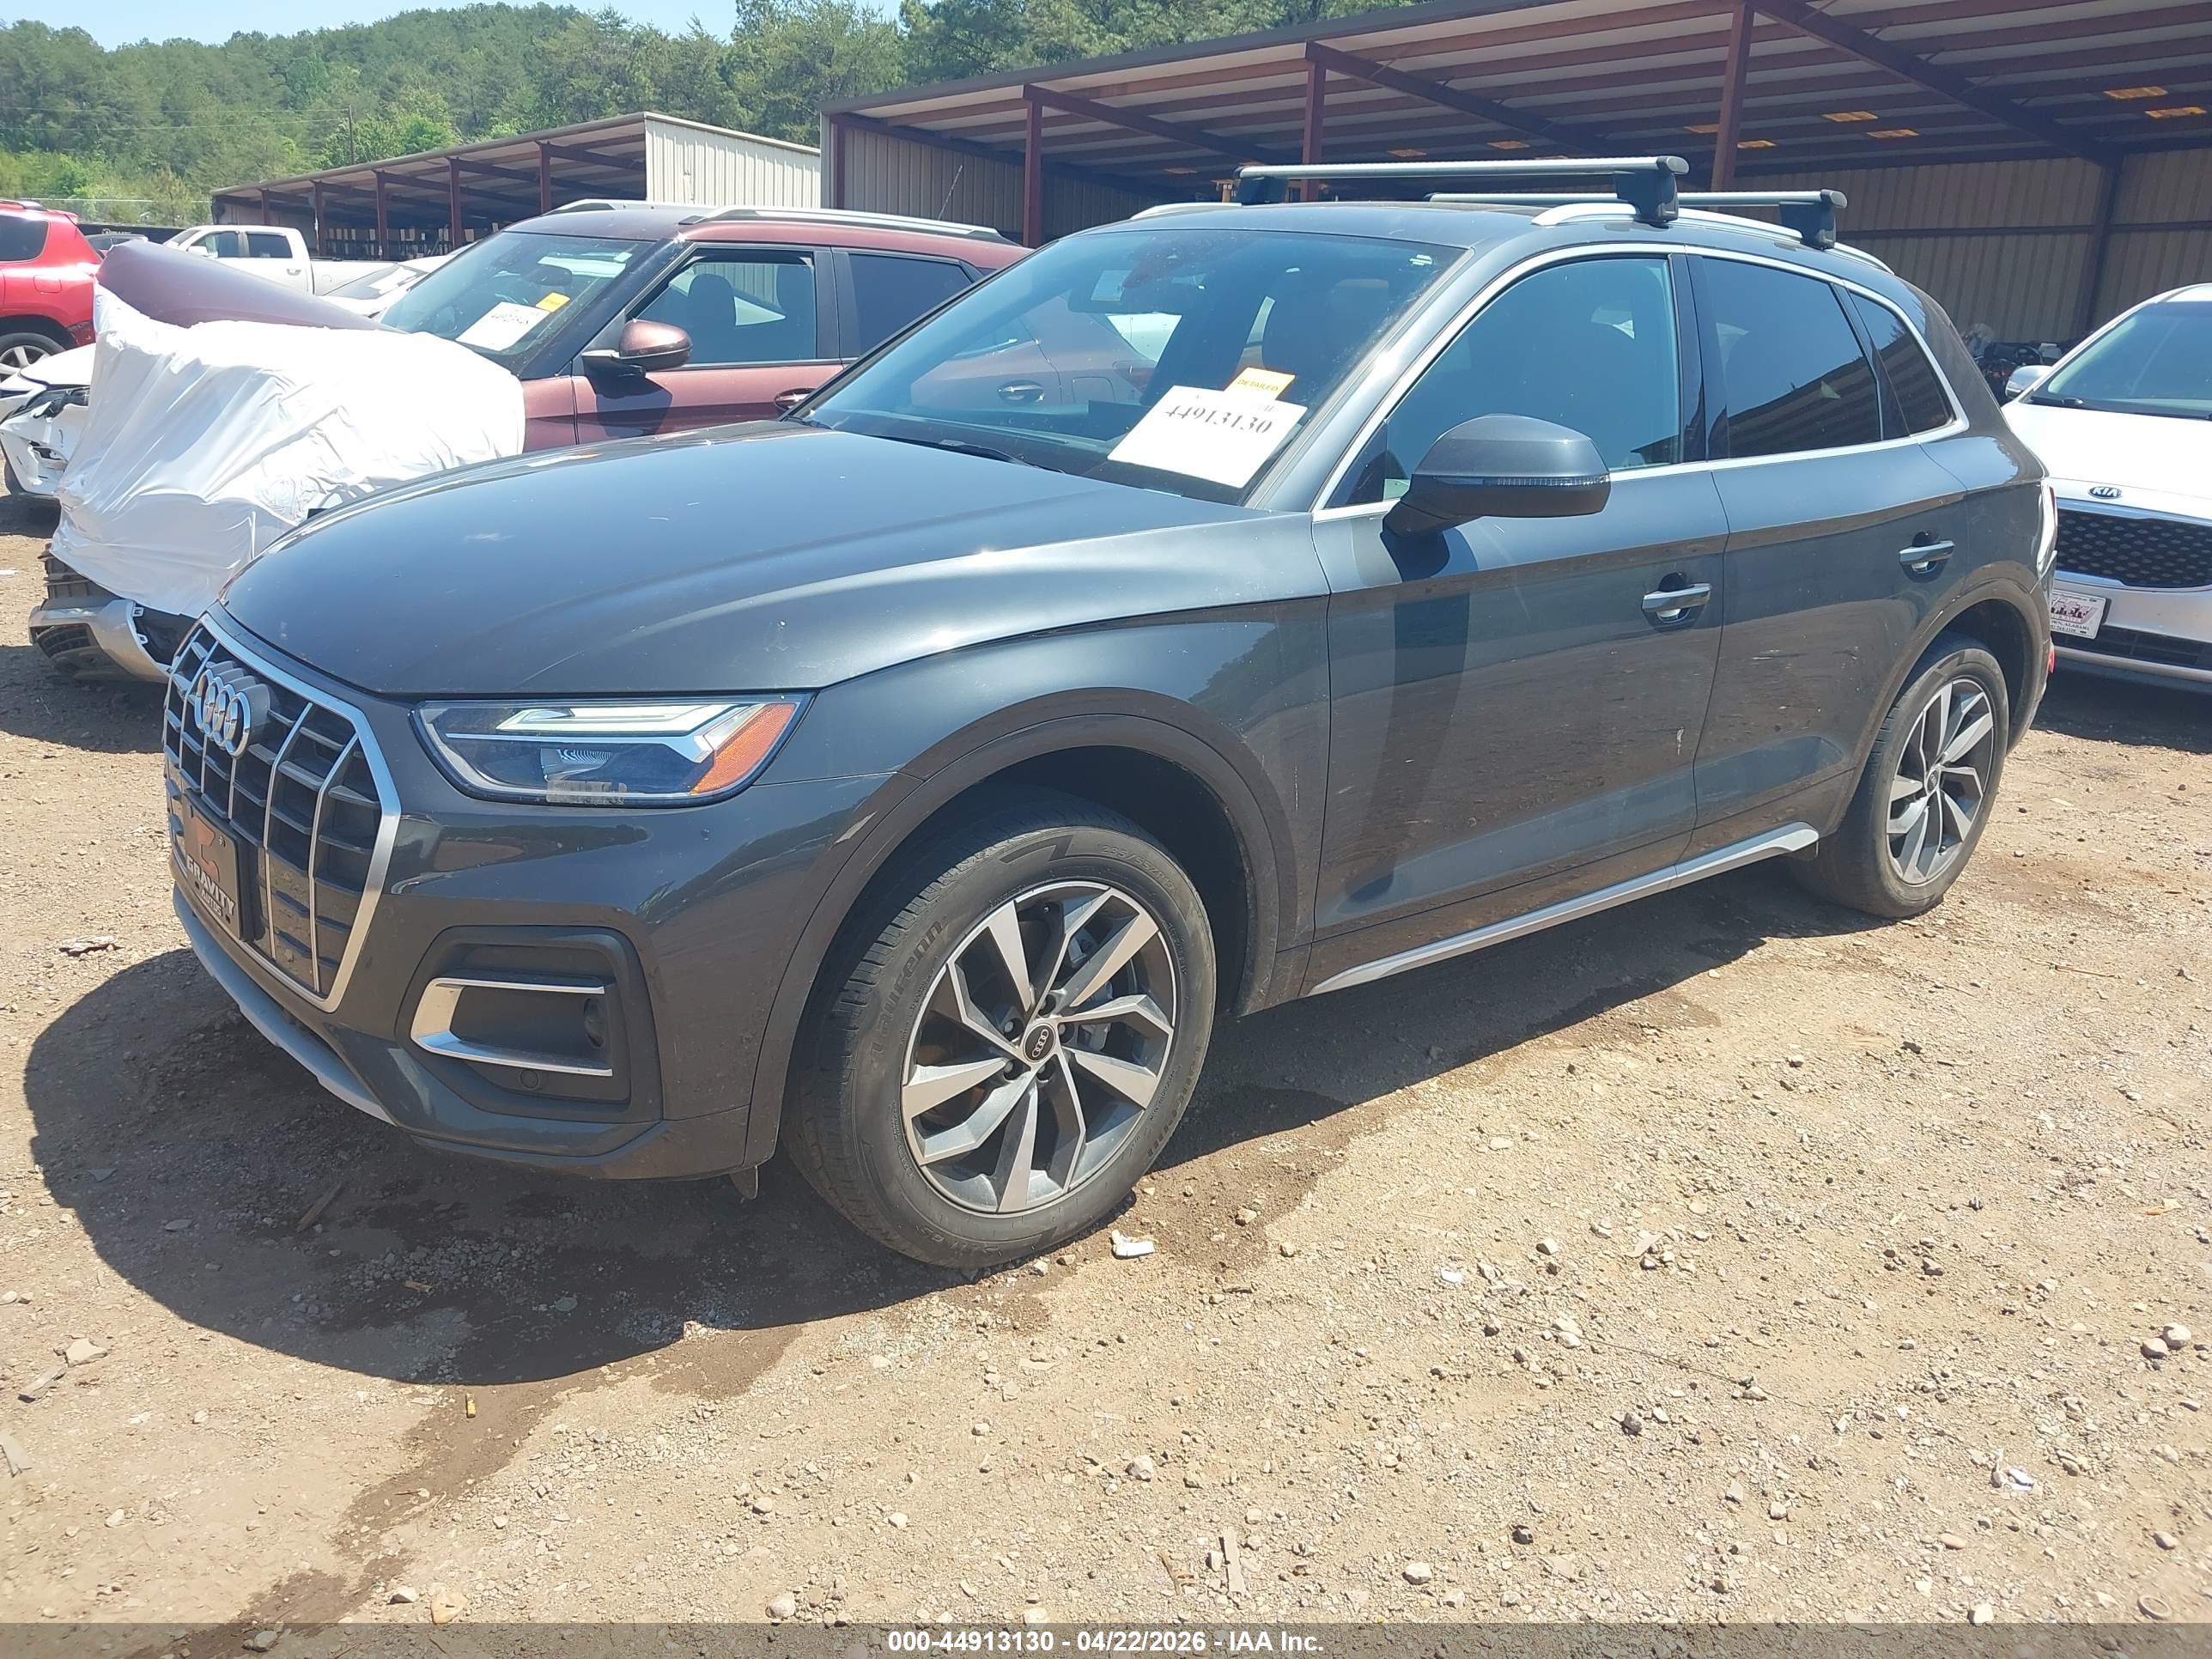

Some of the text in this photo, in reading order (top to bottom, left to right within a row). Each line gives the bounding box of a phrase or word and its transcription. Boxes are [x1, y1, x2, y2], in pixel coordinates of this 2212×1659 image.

[1237, 379, 1279, 391] DETAILED
[1165, 404, 1273, 434] 44913130
[2092, 486, 2118, 497] KIA
[186, 854, 236, 916] GRAVITY
[201, 888, 223, 917] AUTOS
